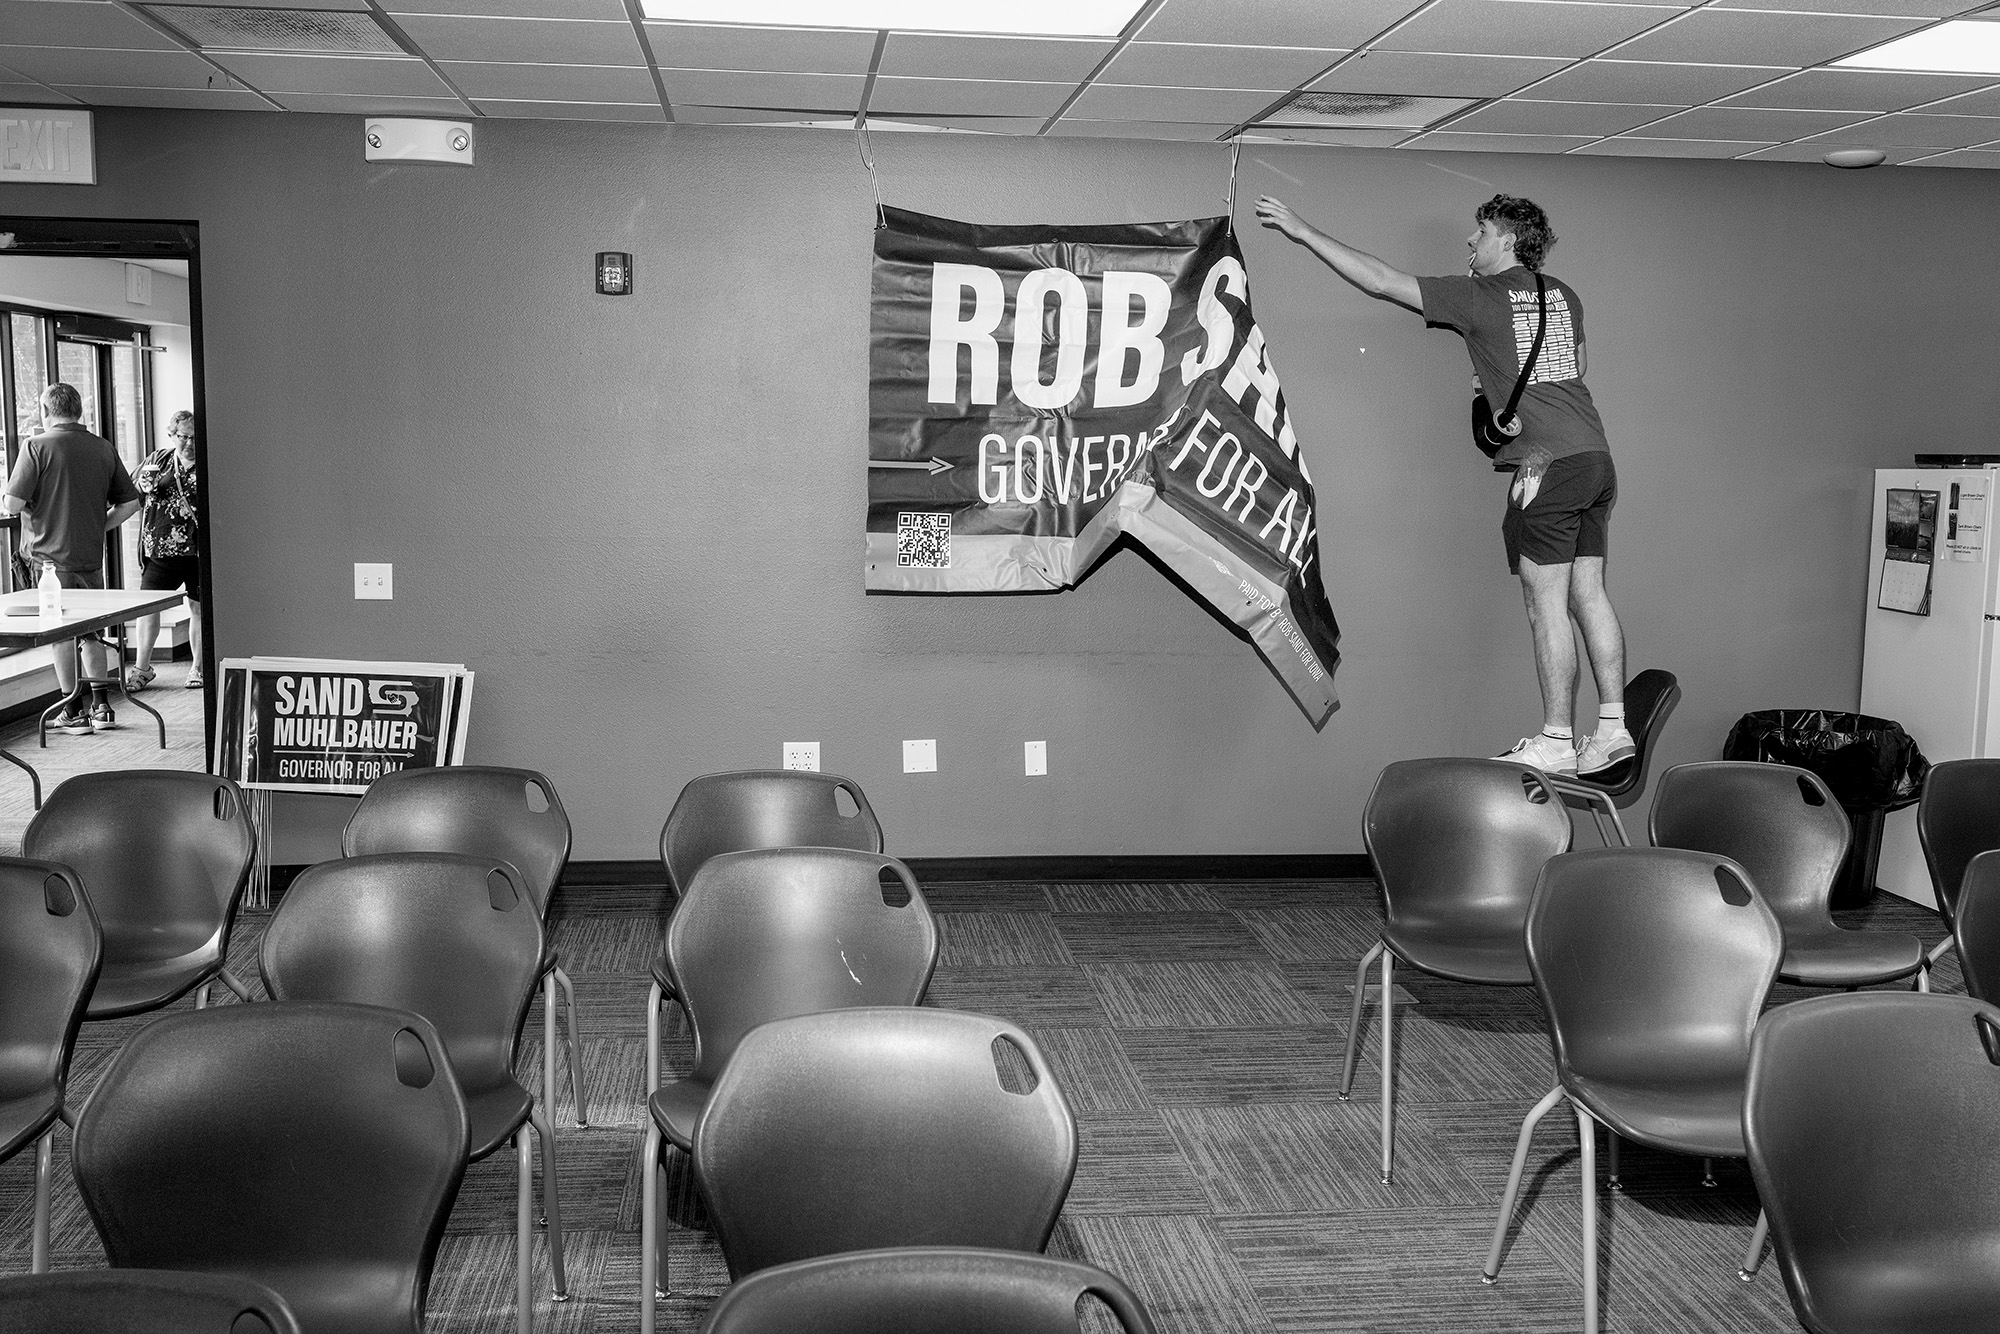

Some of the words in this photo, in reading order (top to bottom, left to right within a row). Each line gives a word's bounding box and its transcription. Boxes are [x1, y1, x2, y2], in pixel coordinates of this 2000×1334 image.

[0, 120, 74, 172] EXIT
[927, 262, 1172, 409] ROB
[1168, 408, 1268, 524] FOR
[1238, 580, 1259, 600] PAID
[1278, 617, 1294, 637] ROB
[1288, 631, 1304, 653] SAND
[1299, 648, 1314, 666] FOR
[1307, 661, 1324, 682] IOWA
[275, 675, 364, 716] SAND
[273, 718, 418, 750] MUHLBAUER
[279, 759, 353, 779] GOVERNOR
[356, 761, 381, 780] FOR
